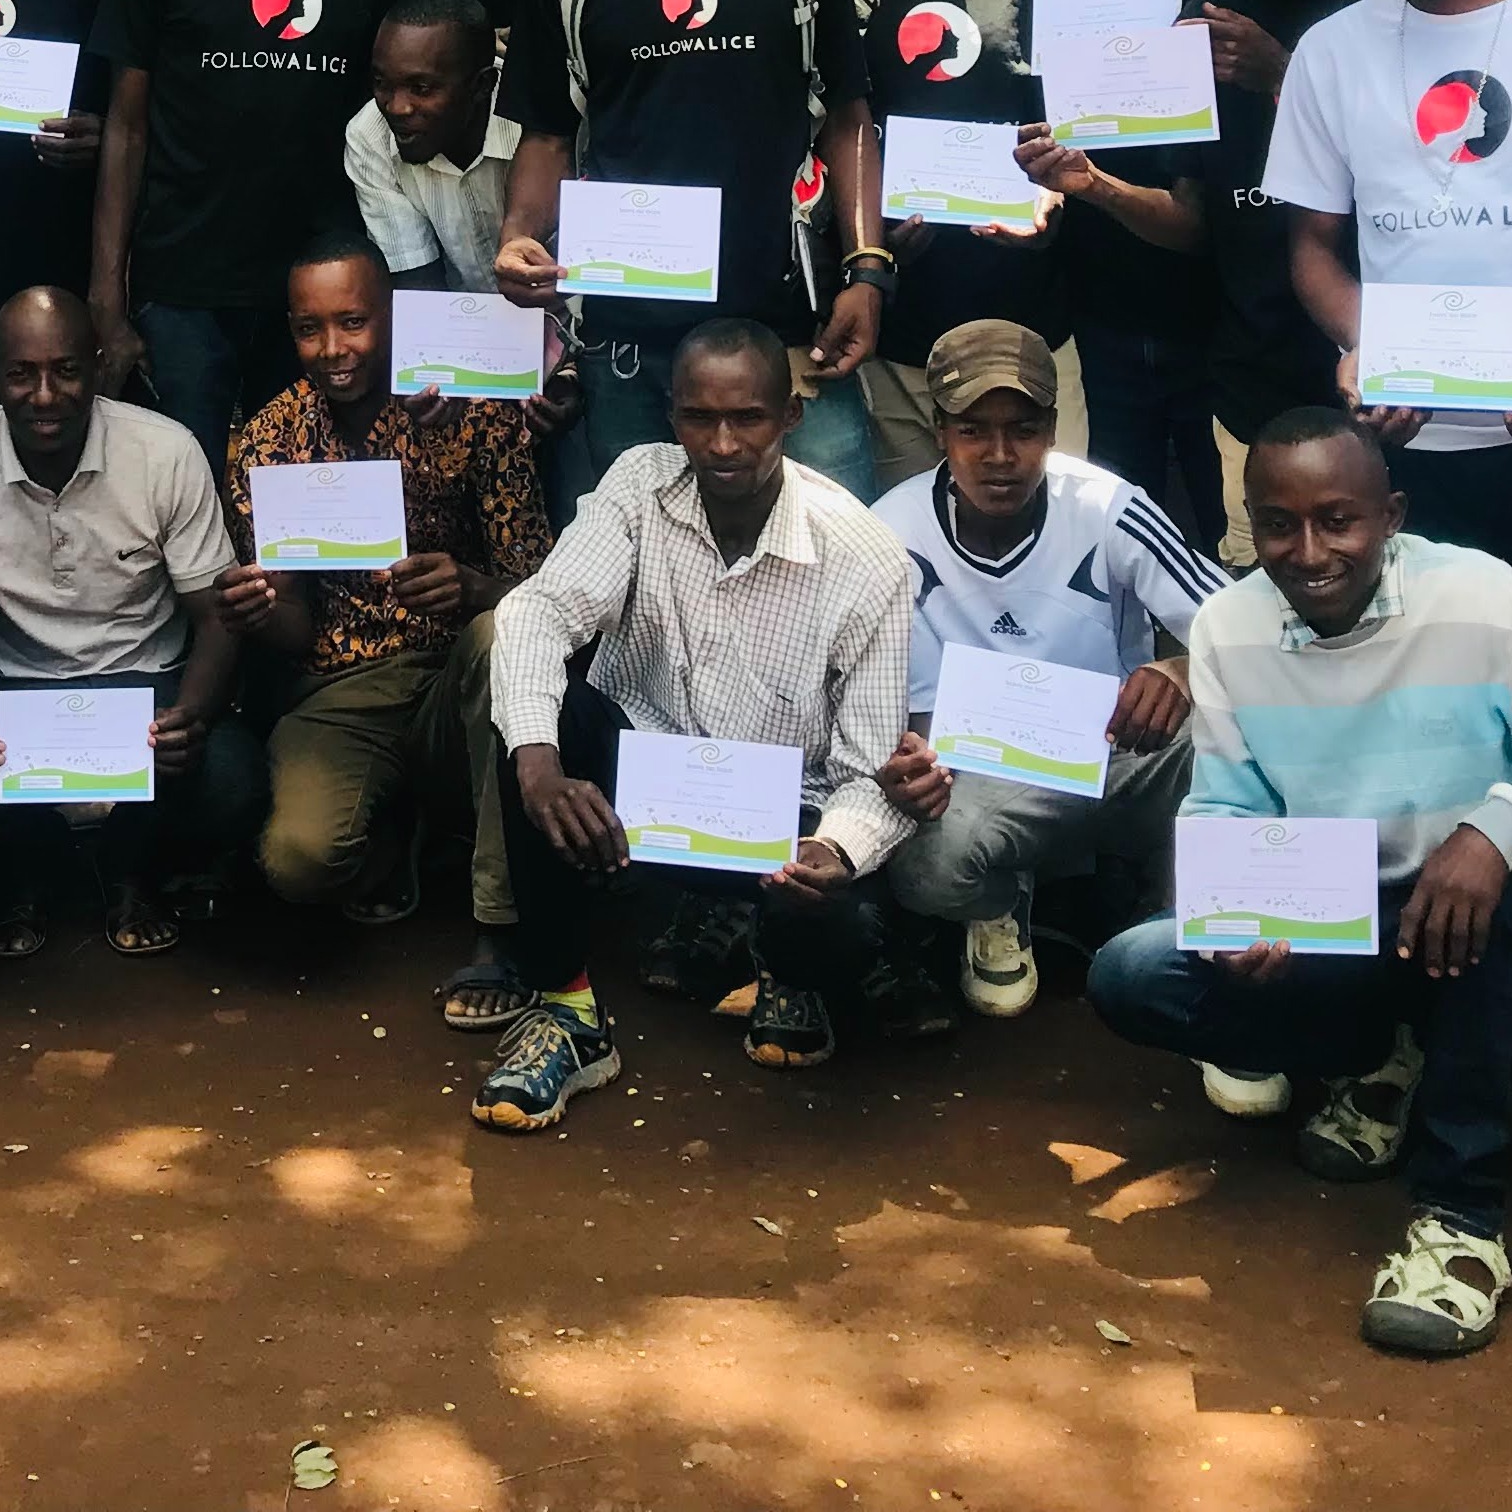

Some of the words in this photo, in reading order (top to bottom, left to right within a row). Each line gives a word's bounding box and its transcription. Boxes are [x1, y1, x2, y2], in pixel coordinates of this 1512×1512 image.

[630, 35, 757, 61] FOLLOWALICE
[201, 51, 347, 75] FOLLOWALICE
[990, 623, 1027, 637] adidas
